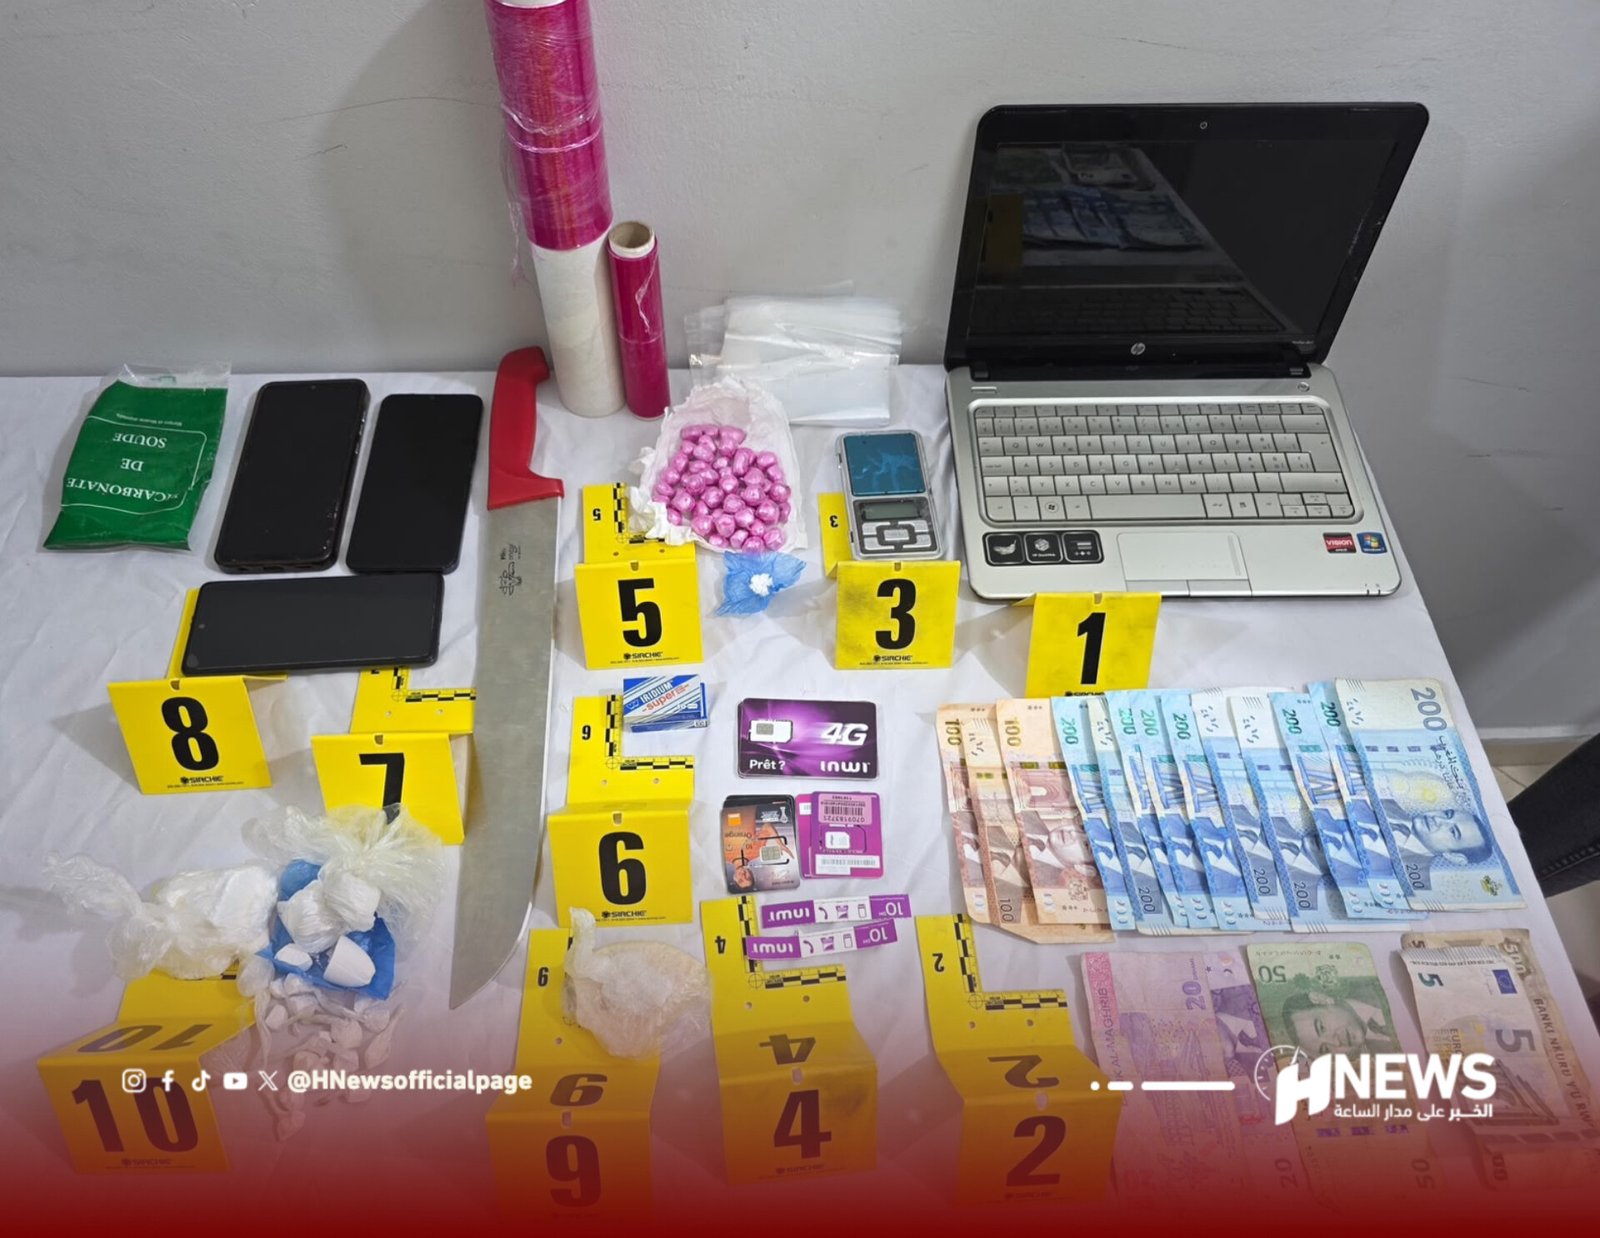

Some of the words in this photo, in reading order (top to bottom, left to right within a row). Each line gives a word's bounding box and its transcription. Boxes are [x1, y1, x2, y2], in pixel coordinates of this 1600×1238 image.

[112, 432, 167, 449] SOUDE
[120, 458, 144, 472] DE
[829, 515, 839, 527] 3
[618, 578, 662, 647] 5
[875, 578, 917, 650] 3
[1077, 612, 1107, 685] 1
[640, 682, 674, 703] IRIDIUM
[646, 690, 678, 710] super
[1140, 709, 1159, 736] 200
[1282, 708, 1302, 734] 200
[1320, 701, 1341, 727] 200
[1410, 687, 1447, 731] 200
[161, 696, 220, 771] 8
[820, 722, 869, 746] 4G
[945, 719, 962, 745] 100
[1005, 717, 1022, 747] 100
[1060, 718, 1079, 745] 200
[1173, 713, 1191, 740] 200
[749, 759, 777, 771] Prêt
[778, 759, 787, 771] ?
[820, 760, 869, 773] inwi
[359, 752, 405, 825] 7
[598, 831, 647, 905] 6
[1405, 863, 1425, 890] 200
[1253, 868, 1271, 896] 200
[1293, 882, 1311, 909] 200
[1000, 898, 1014, 922] 100
[1138, 887, 1156, 913] 200
[714, 935, 726, 954] 4
[932, 953, 945, 973] 2
[1258, 965, 1287, 983] 50
[1418, 973, 1444, 988] 5
[1182, 981, 1206, 1010] 20
[1534, 998, 1555, 1033] BANKI
[759, 1034, 816, 1065] 4
[1495, 1029, 1537, 1053] 5
[987, 1055, 1060, 1088] 2
[71, 1077, 199, 1153] 10
[774, 1089, 832, 1159] 4
[1006, 1115, 1067, 1187] 2
[546, 1135, 601, 1208] 9
